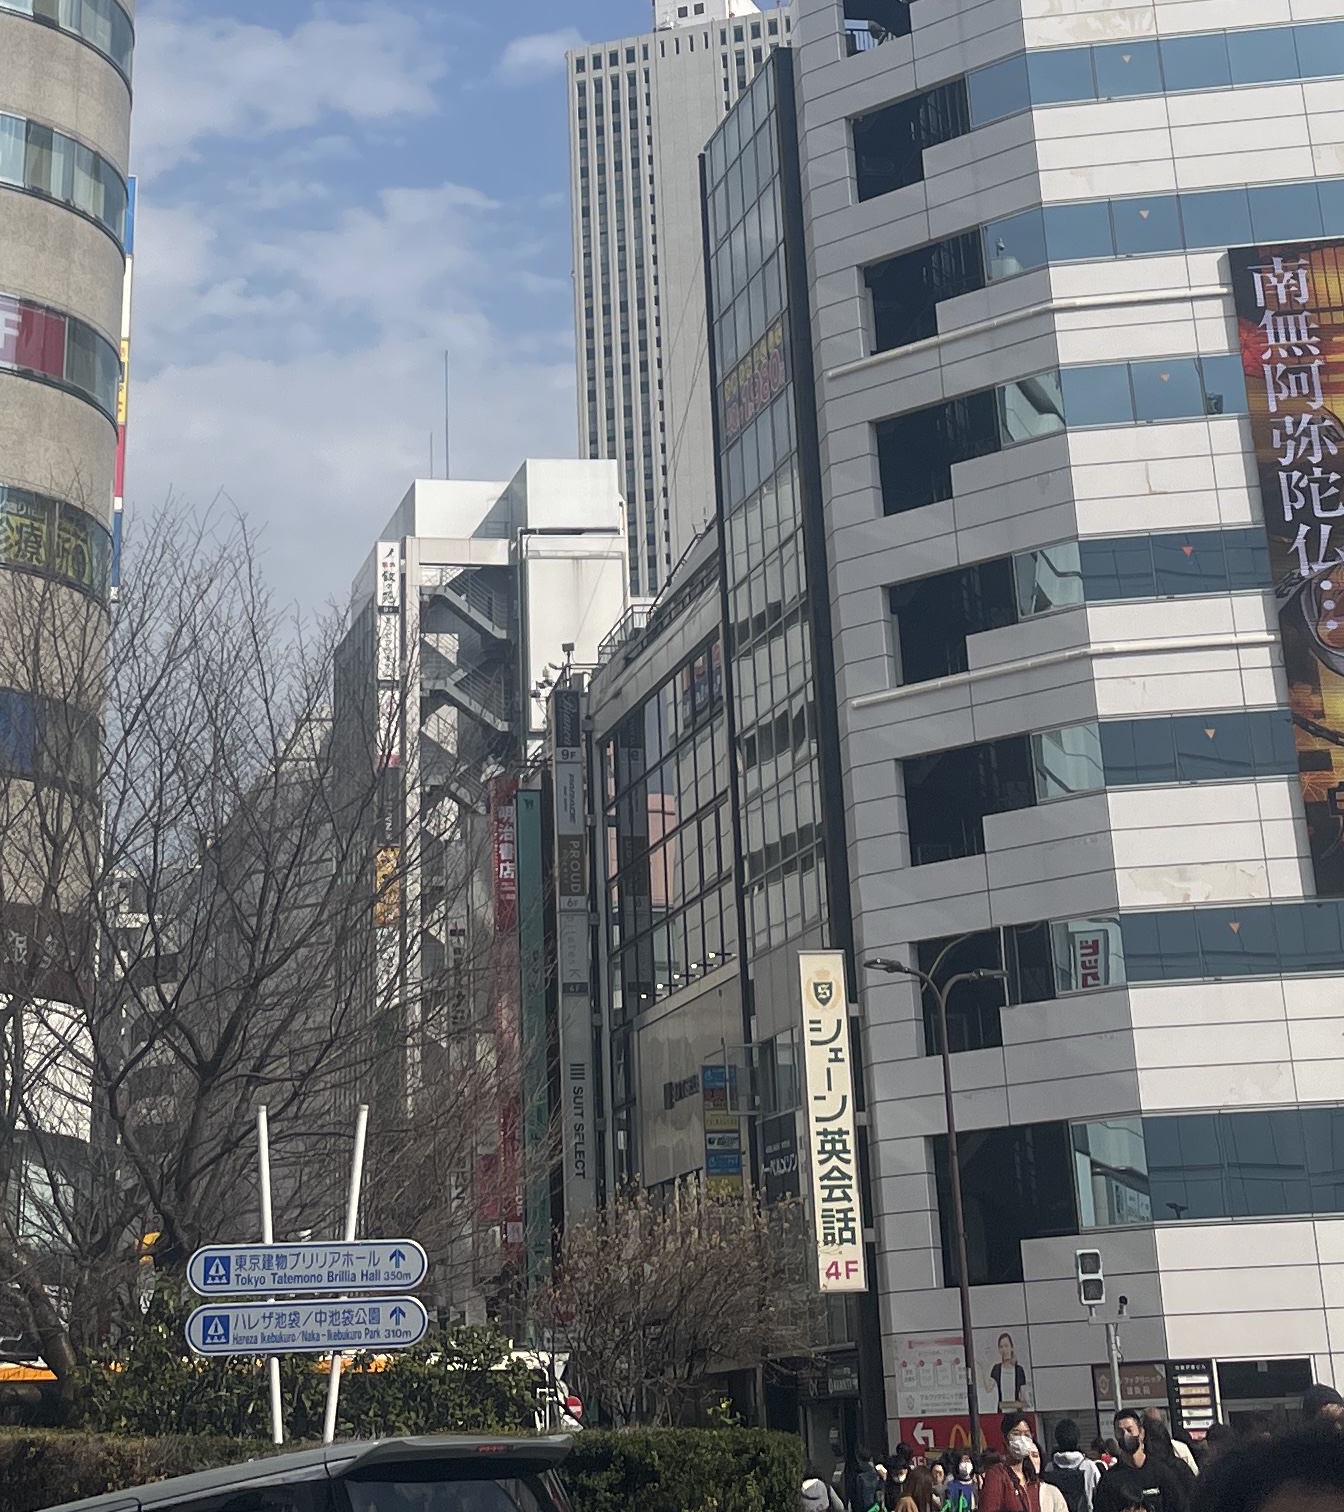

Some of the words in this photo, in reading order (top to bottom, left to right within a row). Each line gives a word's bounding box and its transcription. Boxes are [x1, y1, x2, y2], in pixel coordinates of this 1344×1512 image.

[561, 749, 576, 760] 9F
[570, 841, 581, 893] PROUD
[573, 1086, 584, 1119] SUIT
[809, 1018, 857, 1246] シェーン英会話
[574, 1123, 586, 1179] SELECT
[234, 1250, 381, 1272] 東京建物ブリリアホール
[824, 1259, 859, 1281] 4F
[234, 1273, 266, 1288] Tokyo
[271, 1272, 323, 1286] Tatemono
[327, 1269, 356, 1284] Brillia
[360, 1268, 381, 1282] Hall
[384, 1270, 412, 1281] 350m
[364, 1328, 382, 1340] Park
[384, 1328, 412, 1339] 310m
